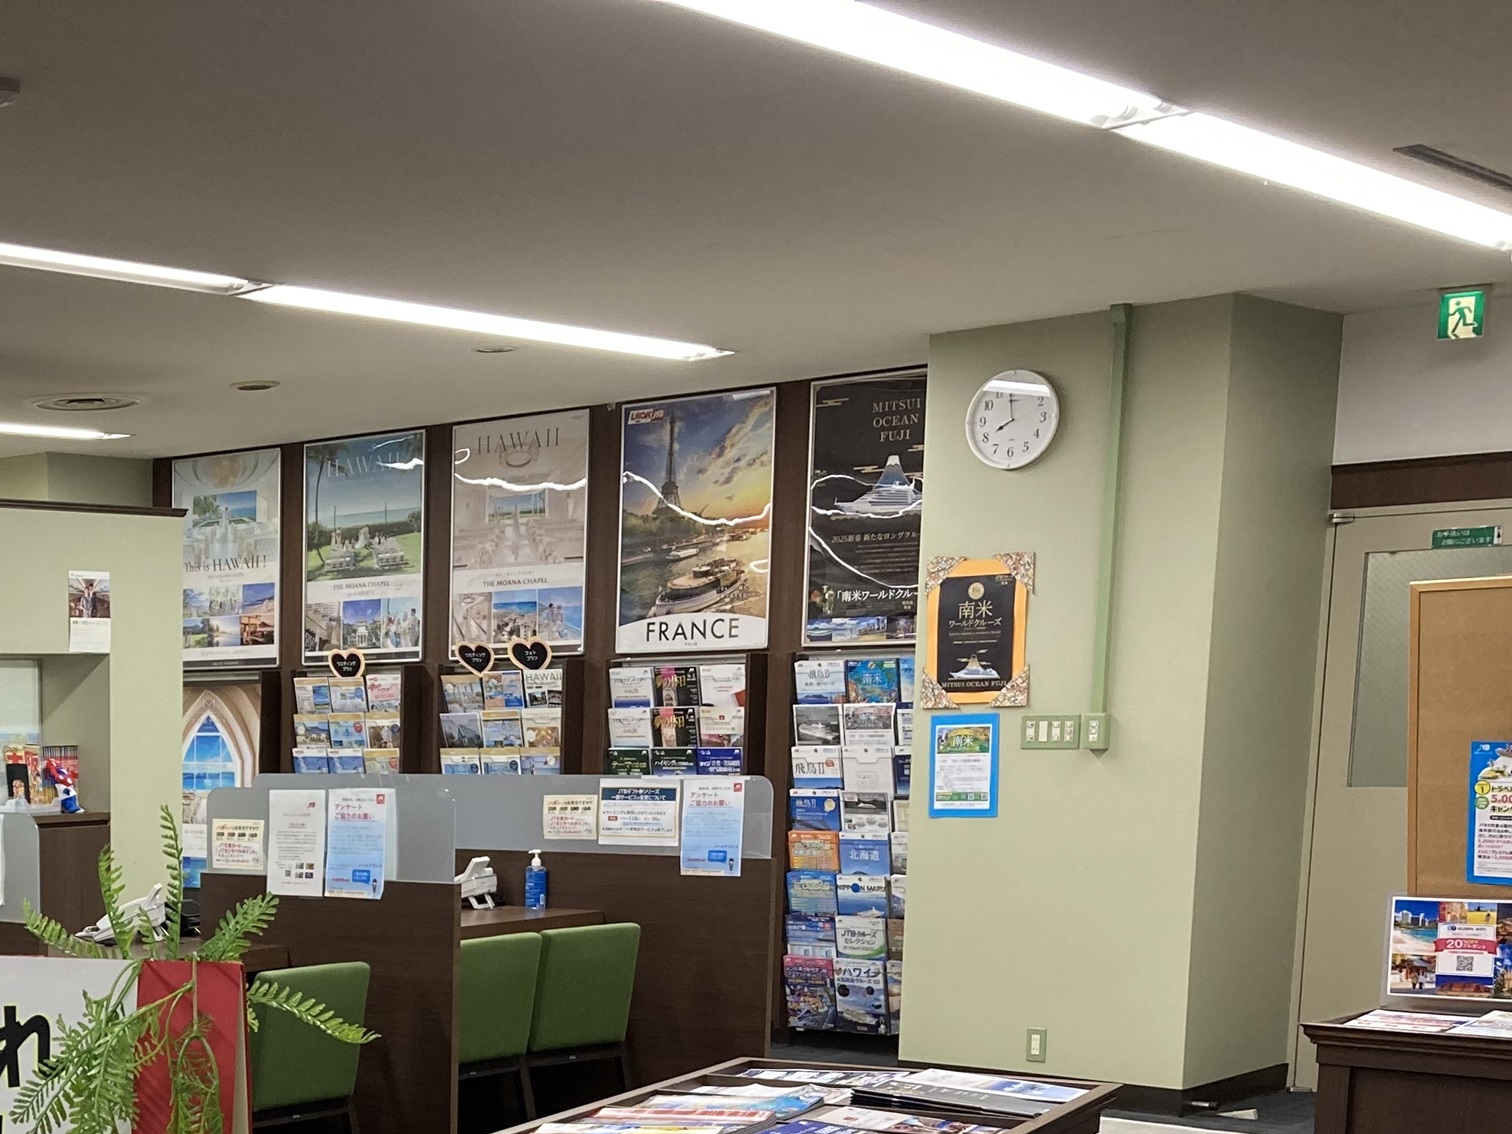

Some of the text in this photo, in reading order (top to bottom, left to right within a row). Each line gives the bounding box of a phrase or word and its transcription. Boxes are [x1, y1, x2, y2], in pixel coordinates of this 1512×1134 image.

[872, 398, 921, 413] MITSUI
[984, 400, 993, 411] 10
[1037, 396, 1044, 406] 2
[873, 414, 919, 428] OCEAN
[980, 416, 986, 427] 9
[1039, 412, 1047, 422] 3
[880, 432, 910, 442] FUJI
[982, 432, 989, 443] 8
[1033, 428, 1039, 438] 4
[477, 427, 560, 455] HAWAII
[992, 444, 999, 454] 7
[1007, 447, 1013, 457] 6
[1022, 442, 1029, 453] 5
[203, 562, 210, 571] is
[523, 577, 548, 585] CHAPEL
[959, 600, 993, 619] 南米
[949, 617, 1002, 628] ワールドクルーズ
[646, 618, 740, 642] FRANCE
[655, 674, 686, 688] 夢の休日
[862, 673, 883, 684] 南米
[654, 715, 685, 729] 夢の休日
[953, 736, 973, 747] 南米
[334, 812, 374, 820] ご協力のお願い
[849, 851, 880, 861] 北海道
[841, 930, 876, 938] JTBクルーズ
